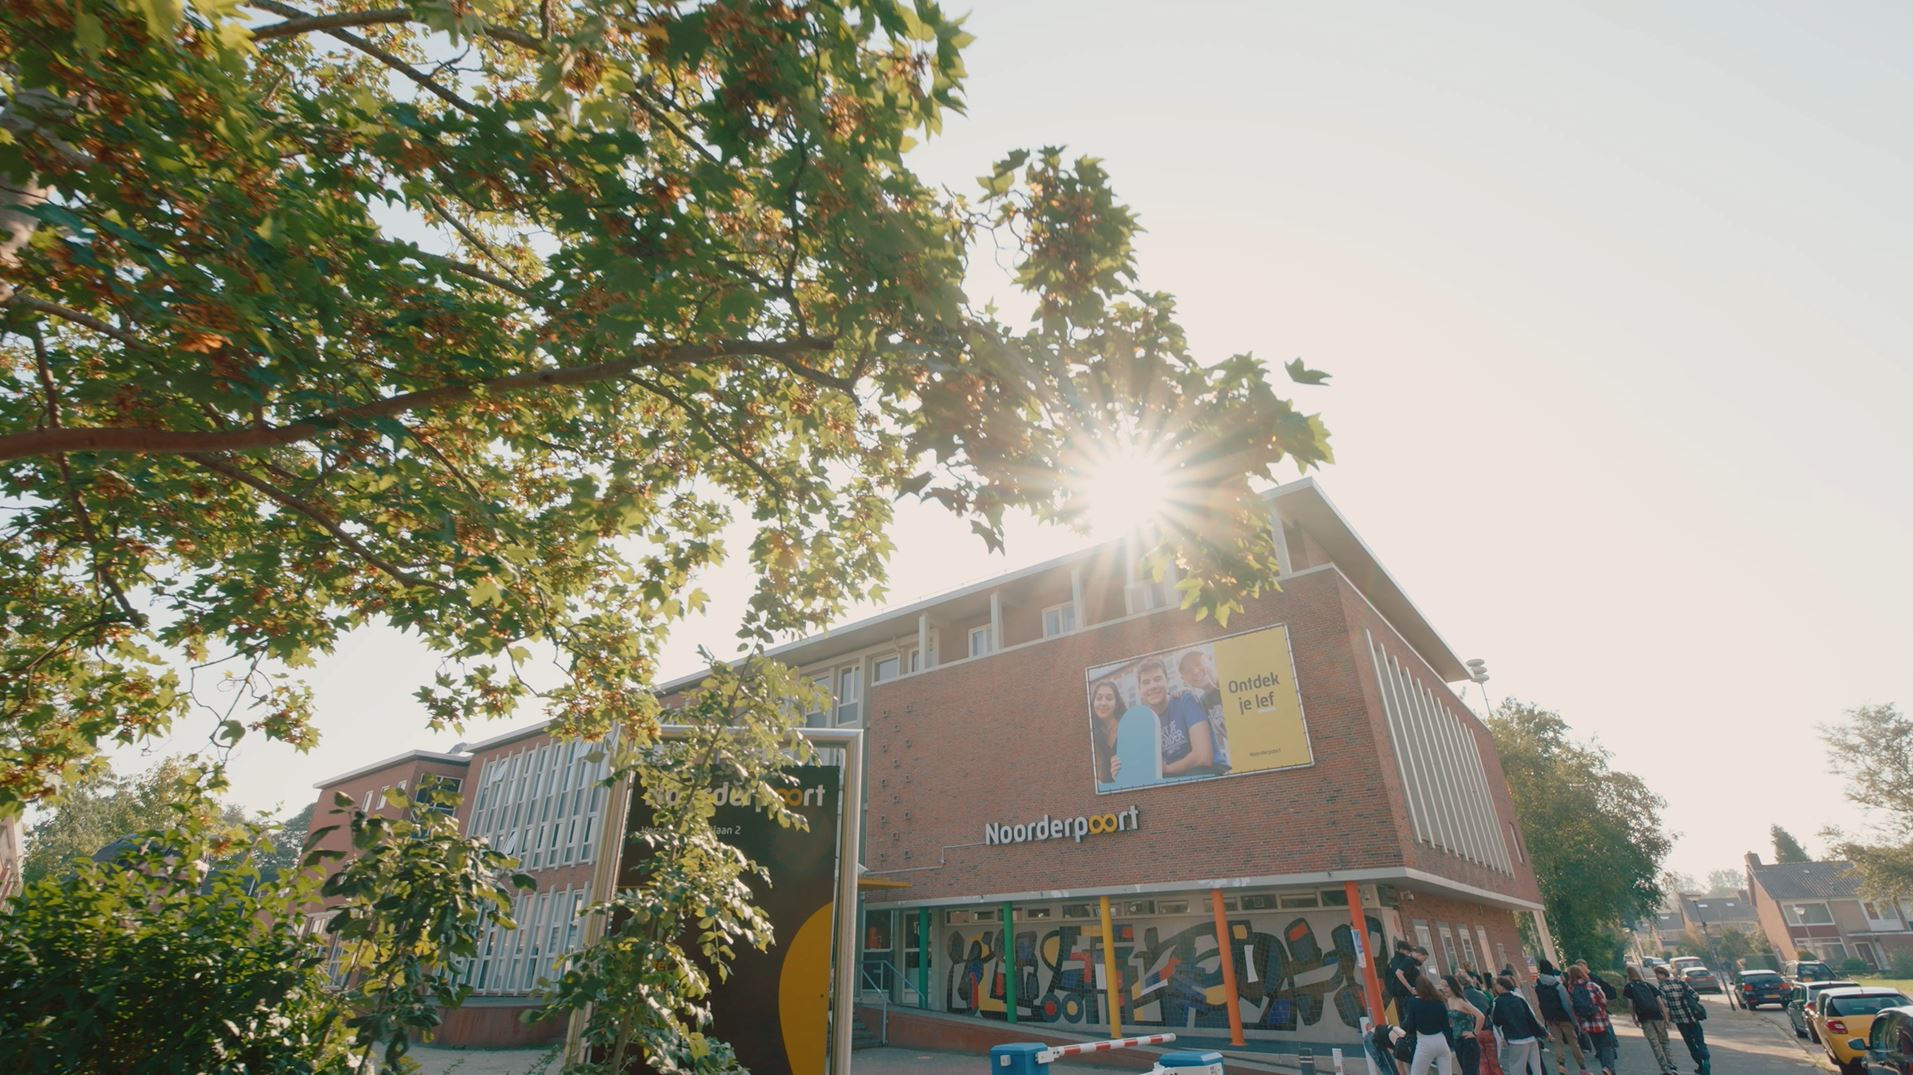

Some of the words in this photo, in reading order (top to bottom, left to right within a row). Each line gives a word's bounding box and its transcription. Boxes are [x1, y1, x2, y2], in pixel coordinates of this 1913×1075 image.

[1228, 672, 1280, 694] Ontdek
[1238, 697, 1252, 715] je
[1255, 691, 1275, 708] lef
[734, 825, 742, 835] 2
[985, 805, 1139, 846] Noorderpoort
